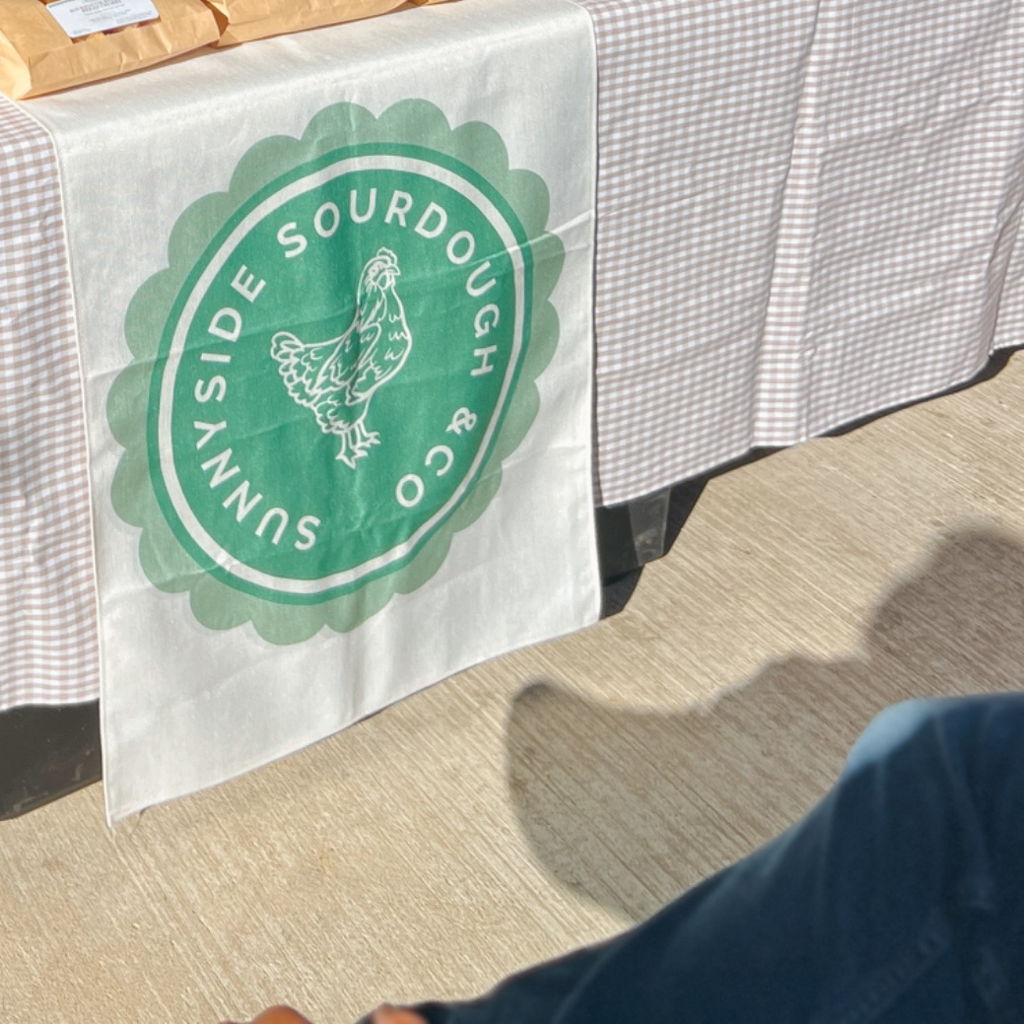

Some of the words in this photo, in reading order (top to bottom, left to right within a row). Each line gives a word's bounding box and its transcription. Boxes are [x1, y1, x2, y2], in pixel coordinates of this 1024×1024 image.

[276, 187, 502, 377] SOURDOUGH
[193, 265, 321, 552] SUNNYSIDE
[446, 406, 478, 434] &
[395, 443, 454, 508] CO
